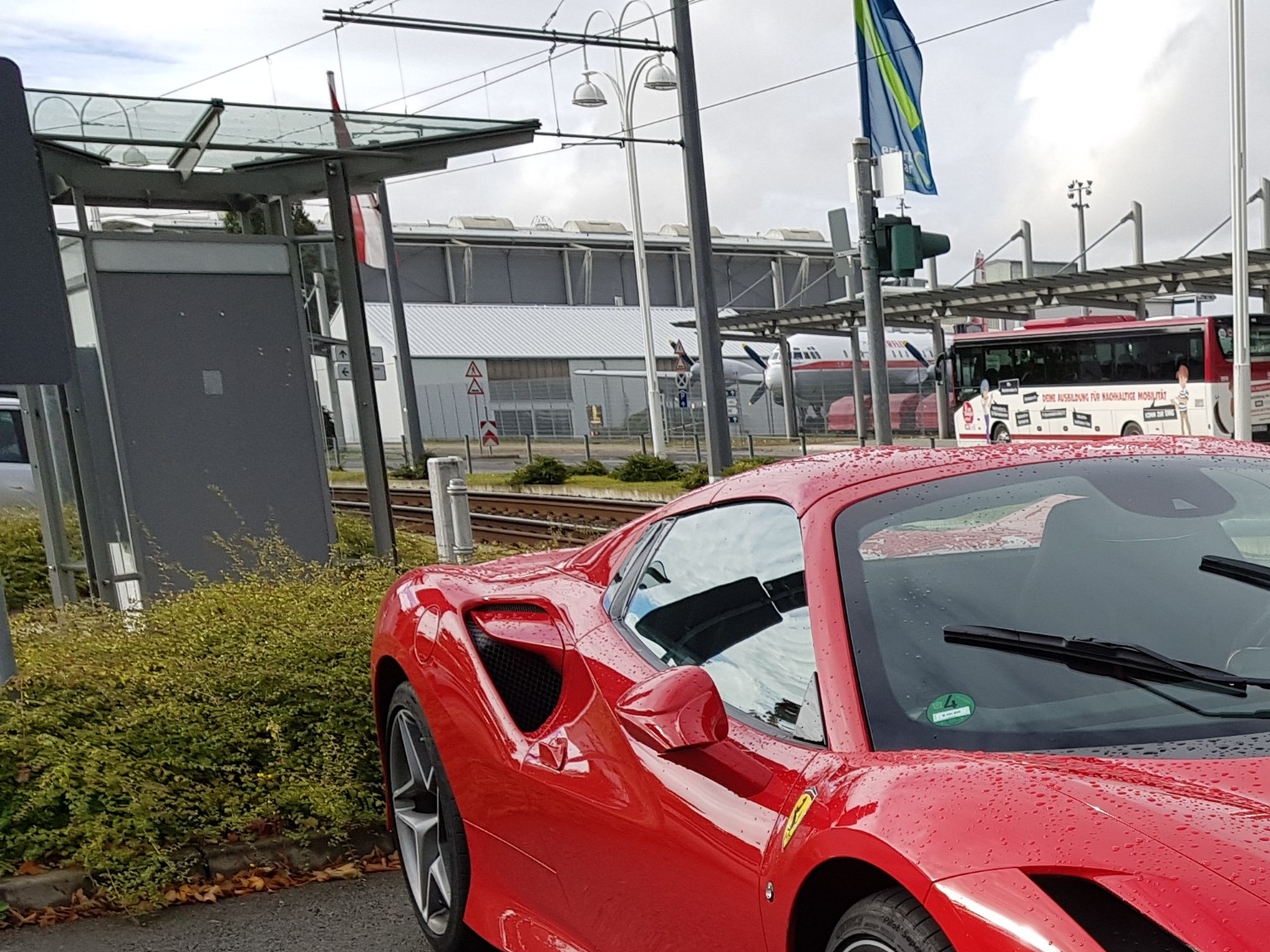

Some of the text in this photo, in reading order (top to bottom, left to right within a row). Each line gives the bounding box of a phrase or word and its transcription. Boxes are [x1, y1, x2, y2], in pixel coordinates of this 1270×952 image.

[1042, 393, 1056, 402] DEINE
[1057, 392, 1089, 402] AUSBILDUNG
[1090, 390, 1100, 401] FÜR
[1102, 391, 1136, 401] NACHHALTIGE
[1138, 389, 1167, 401] MOBILITÄT
[944, 694, 957, 709] 4
